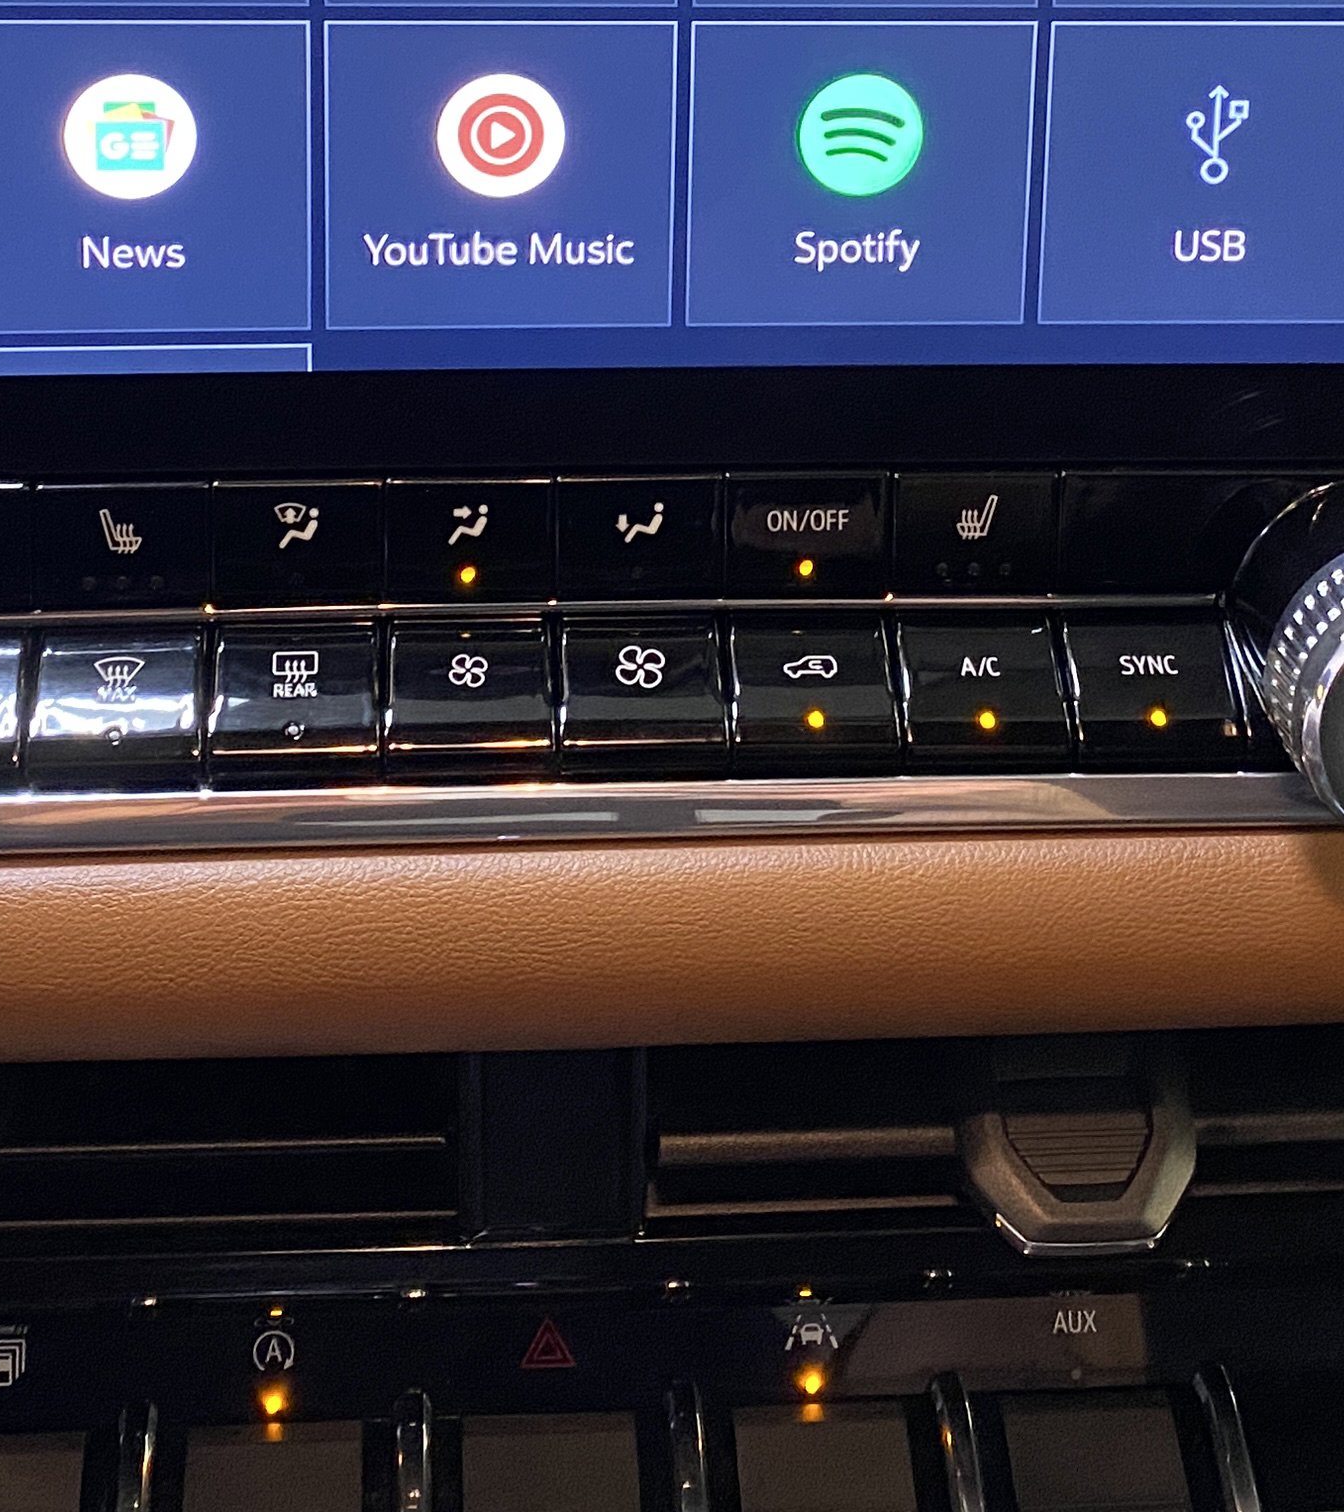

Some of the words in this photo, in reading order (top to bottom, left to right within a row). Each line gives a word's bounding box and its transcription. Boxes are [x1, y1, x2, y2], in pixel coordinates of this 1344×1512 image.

[81, 234, 187, 270] News
[362, 231, 519, 266] YouTube
[528, 231, 635, 266] Music
[793, 228, 921, 272] Spotify
[1172, 230, 1248, 262] USB
[766, 508, 850, 533] ON/OFF
[959, 656, 1002, 678] A/C
[1118, 654, 1180, 677] SYNC
[271, 681, 319, 700] REAR
[1052, 1309, 1097, 1336] AUX
